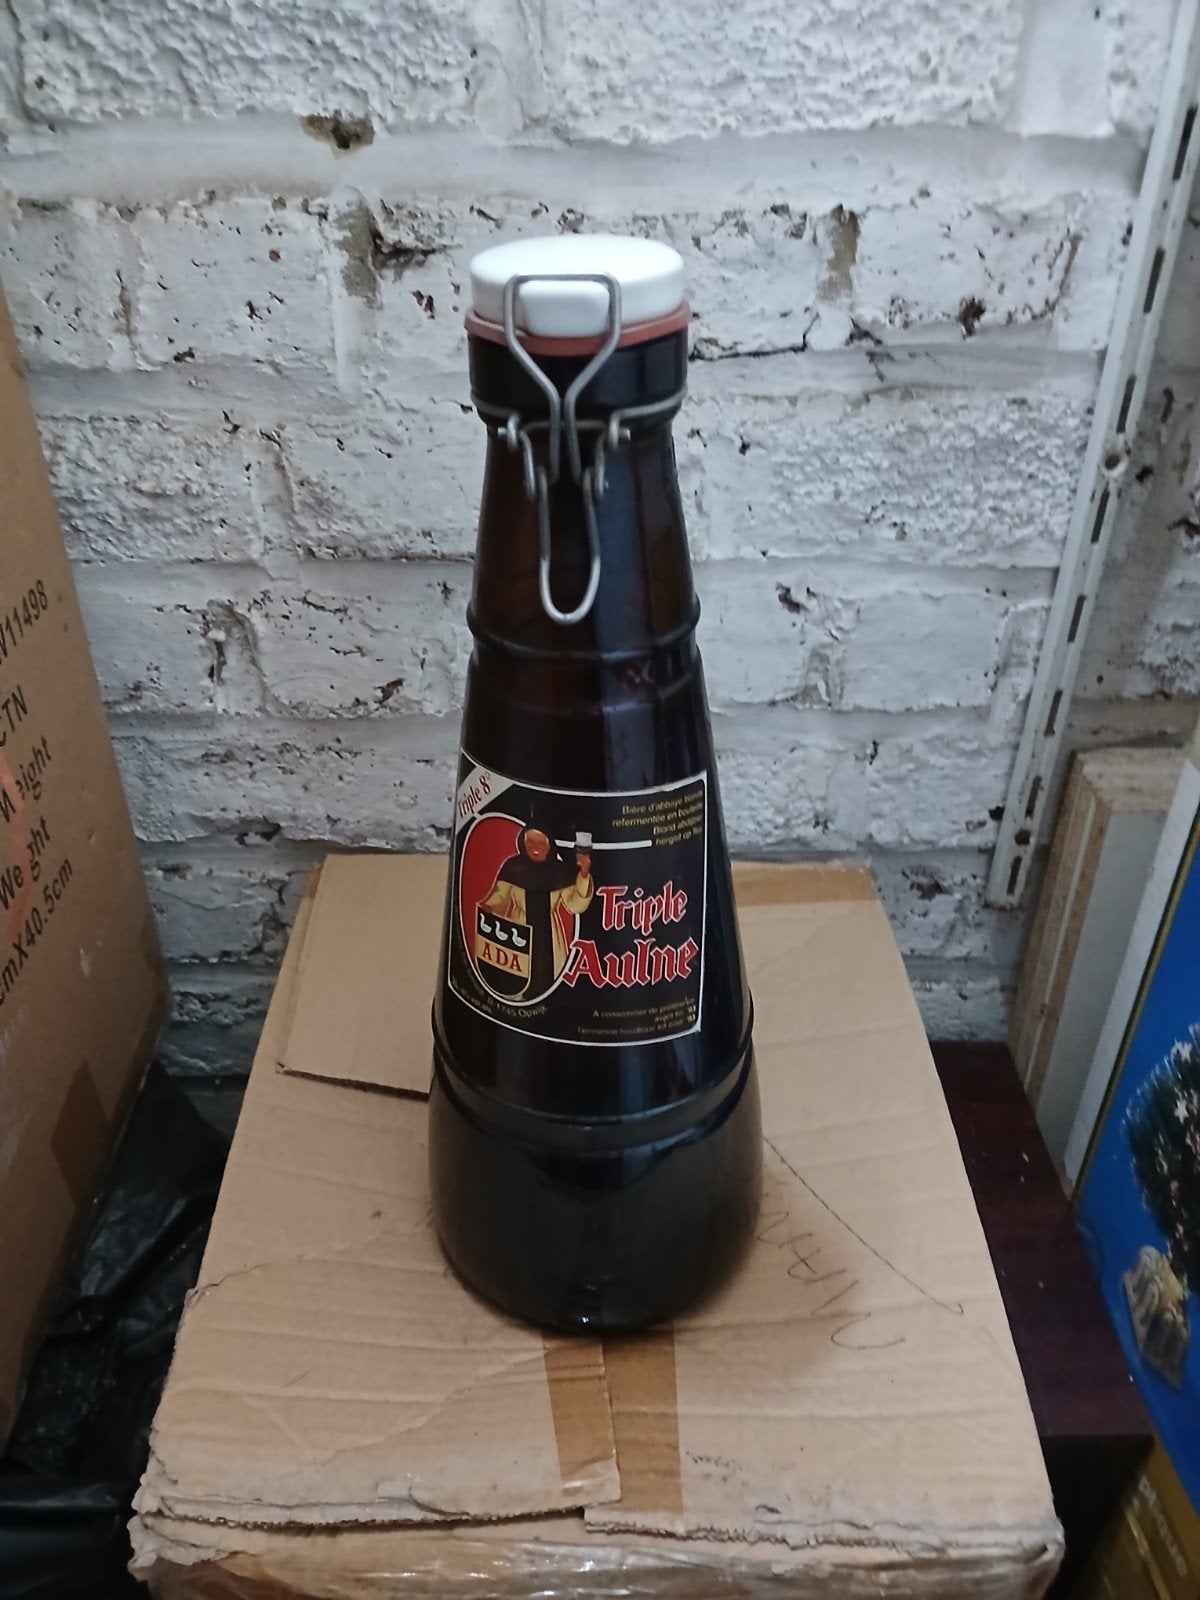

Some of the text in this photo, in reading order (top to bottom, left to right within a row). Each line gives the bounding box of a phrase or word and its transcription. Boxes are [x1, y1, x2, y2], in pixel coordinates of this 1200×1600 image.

[0, 815, 50, 911] Weght
[596, 880, 688, 936] Triple
[482, 941, 522, 972] ADA
[562, 936, 699, 988] Aulne
